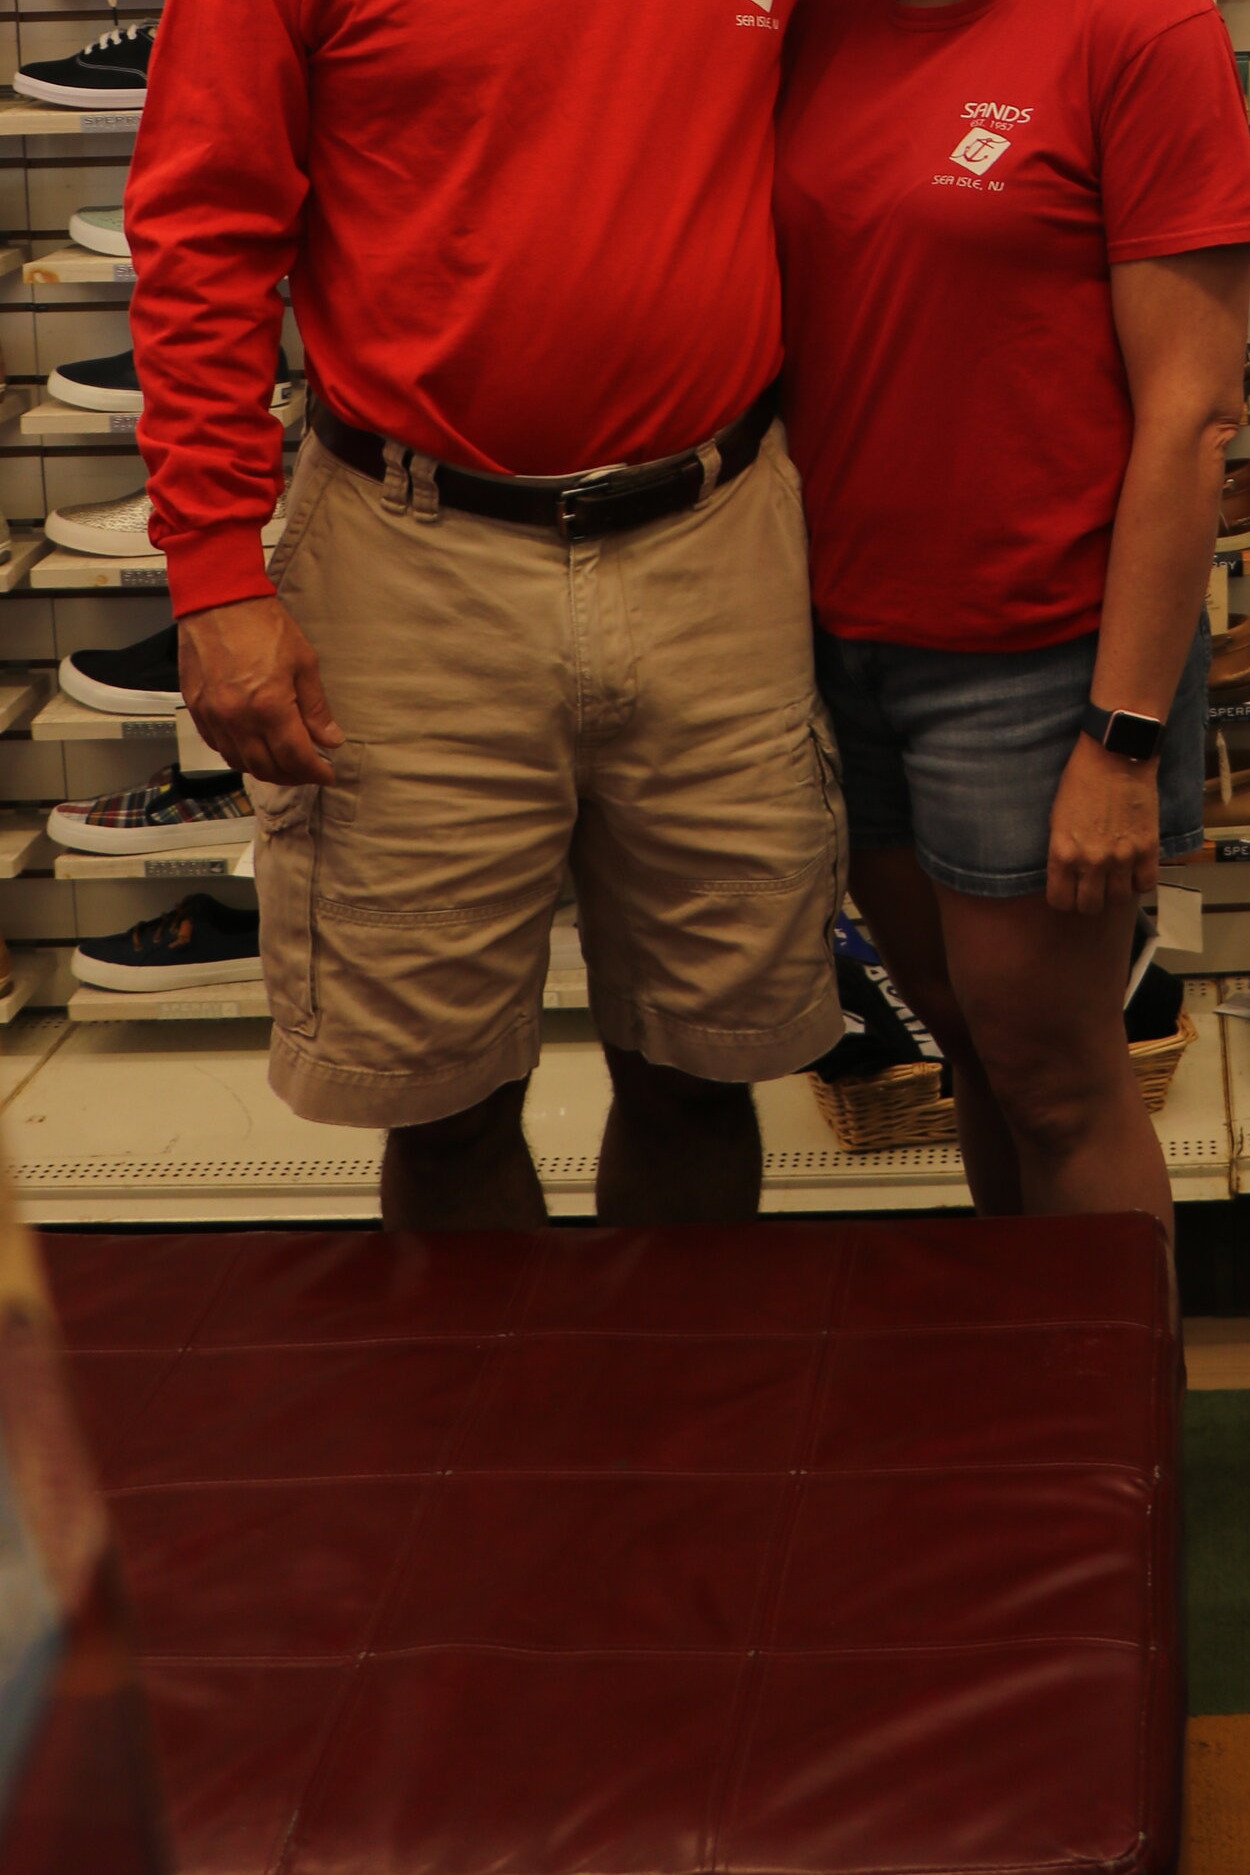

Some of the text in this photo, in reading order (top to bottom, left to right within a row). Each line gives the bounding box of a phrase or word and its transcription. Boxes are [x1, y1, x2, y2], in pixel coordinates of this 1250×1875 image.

[735, 14, 755, 27] SEA
[960, 102, 1034, 123] SANDS
[989, 120, 1015, 131] 1957
[931, 174, 955, 185] SEA
[987, 180, 1005, 191] NJ
